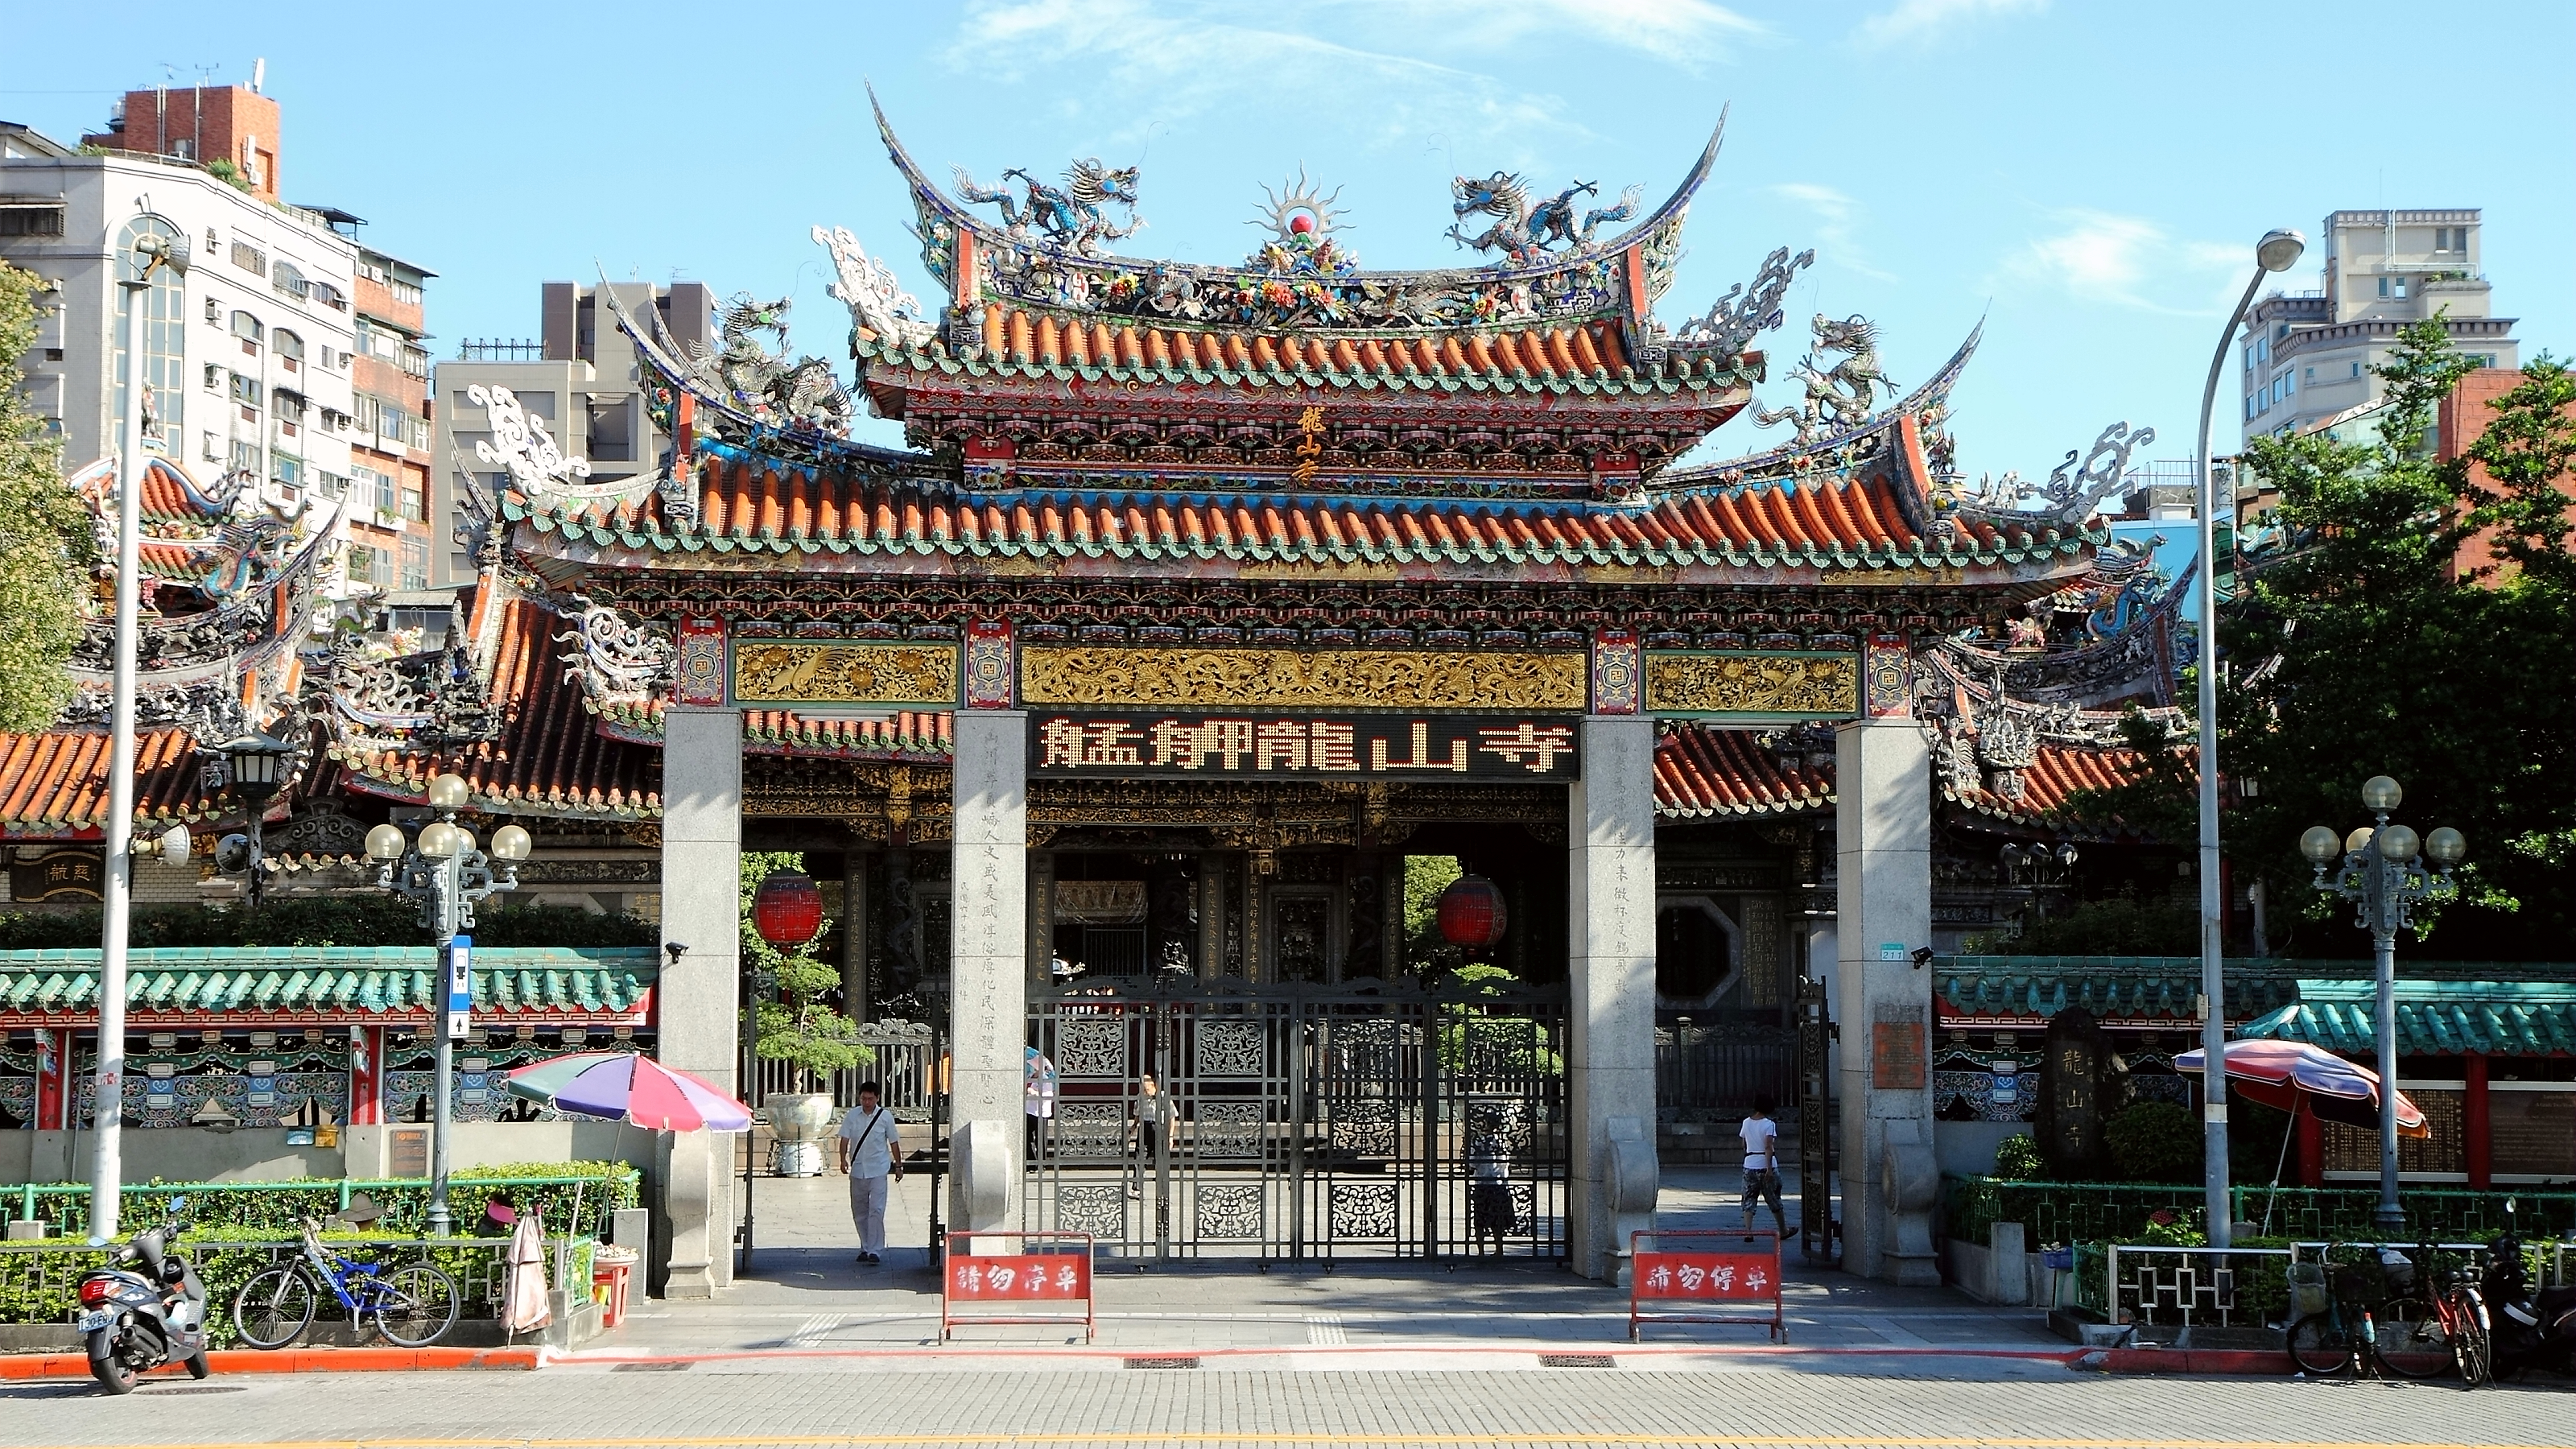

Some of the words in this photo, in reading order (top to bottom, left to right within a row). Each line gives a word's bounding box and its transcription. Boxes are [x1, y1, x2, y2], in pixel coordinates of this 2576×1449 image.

[1291, 407, 1327, 488] 龍山寺
[1039, 719, 1575, 773] 艋舺龍山寺
[1882, 951, 1903, 960] 211
[2062, 1049, 2084, 1146] 龍山寺
[957, 1263, 1078, 1292] 請勿停車
[1646, 1263, 1768, 1293] 請勿停車
